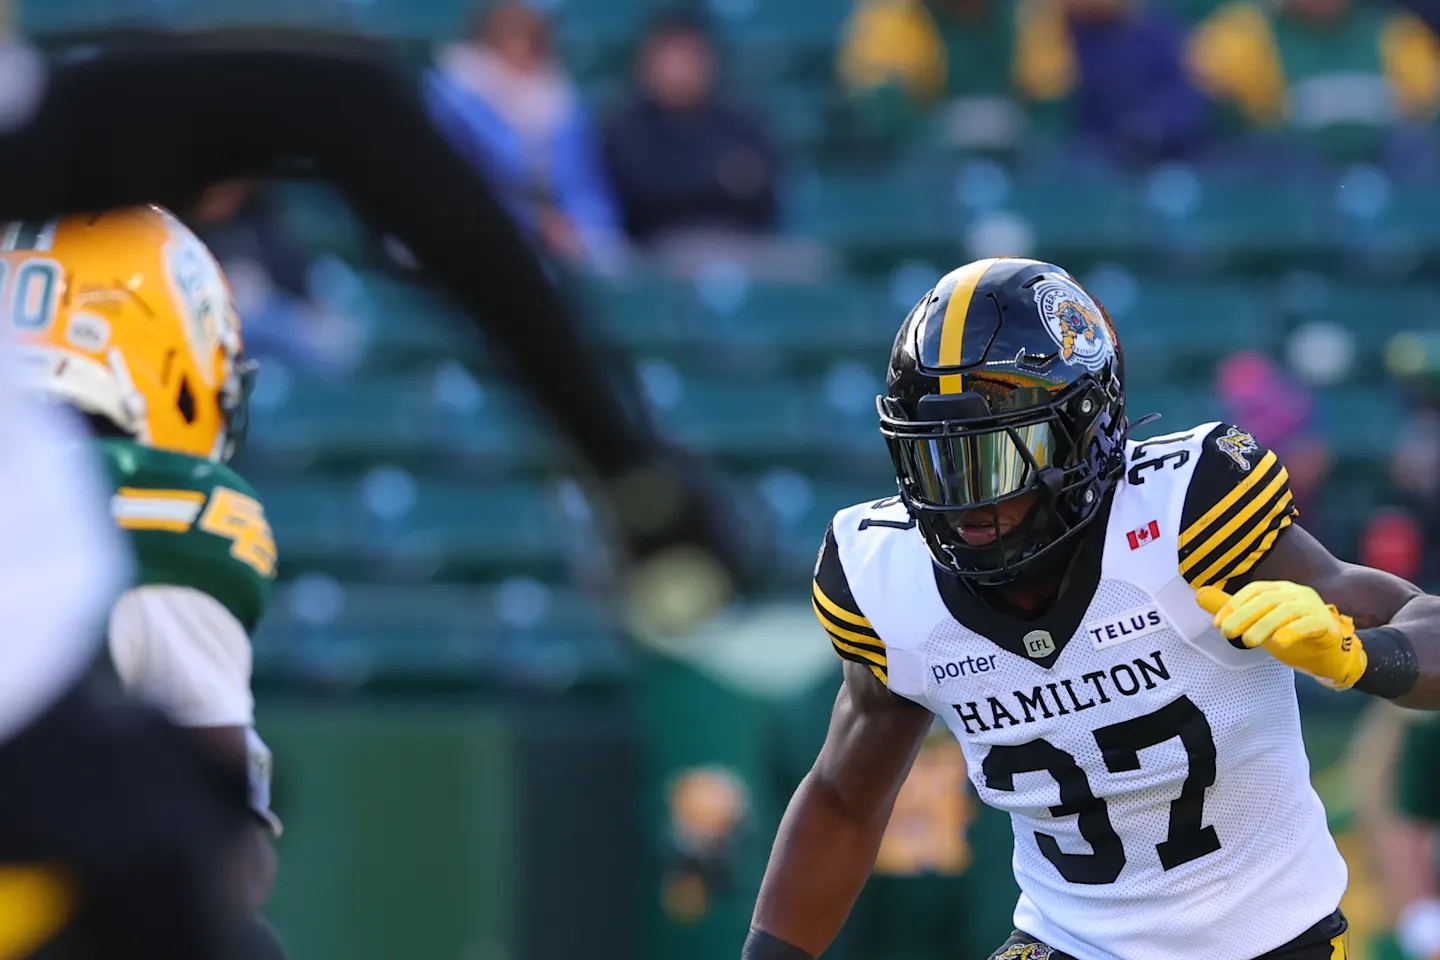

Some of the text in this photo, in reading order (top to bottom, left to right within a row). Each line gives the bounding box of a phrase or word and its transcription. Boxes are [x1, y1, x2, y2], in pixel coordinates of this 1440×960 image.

[1090, 610, 1161, 644] TELUS
[1029, 638, 1050, 652] CFL
[931, 654, 997, 684] porter
[952, 651, 1171, 734] HAMILTON
[982, 694, 1221, 885] 37
